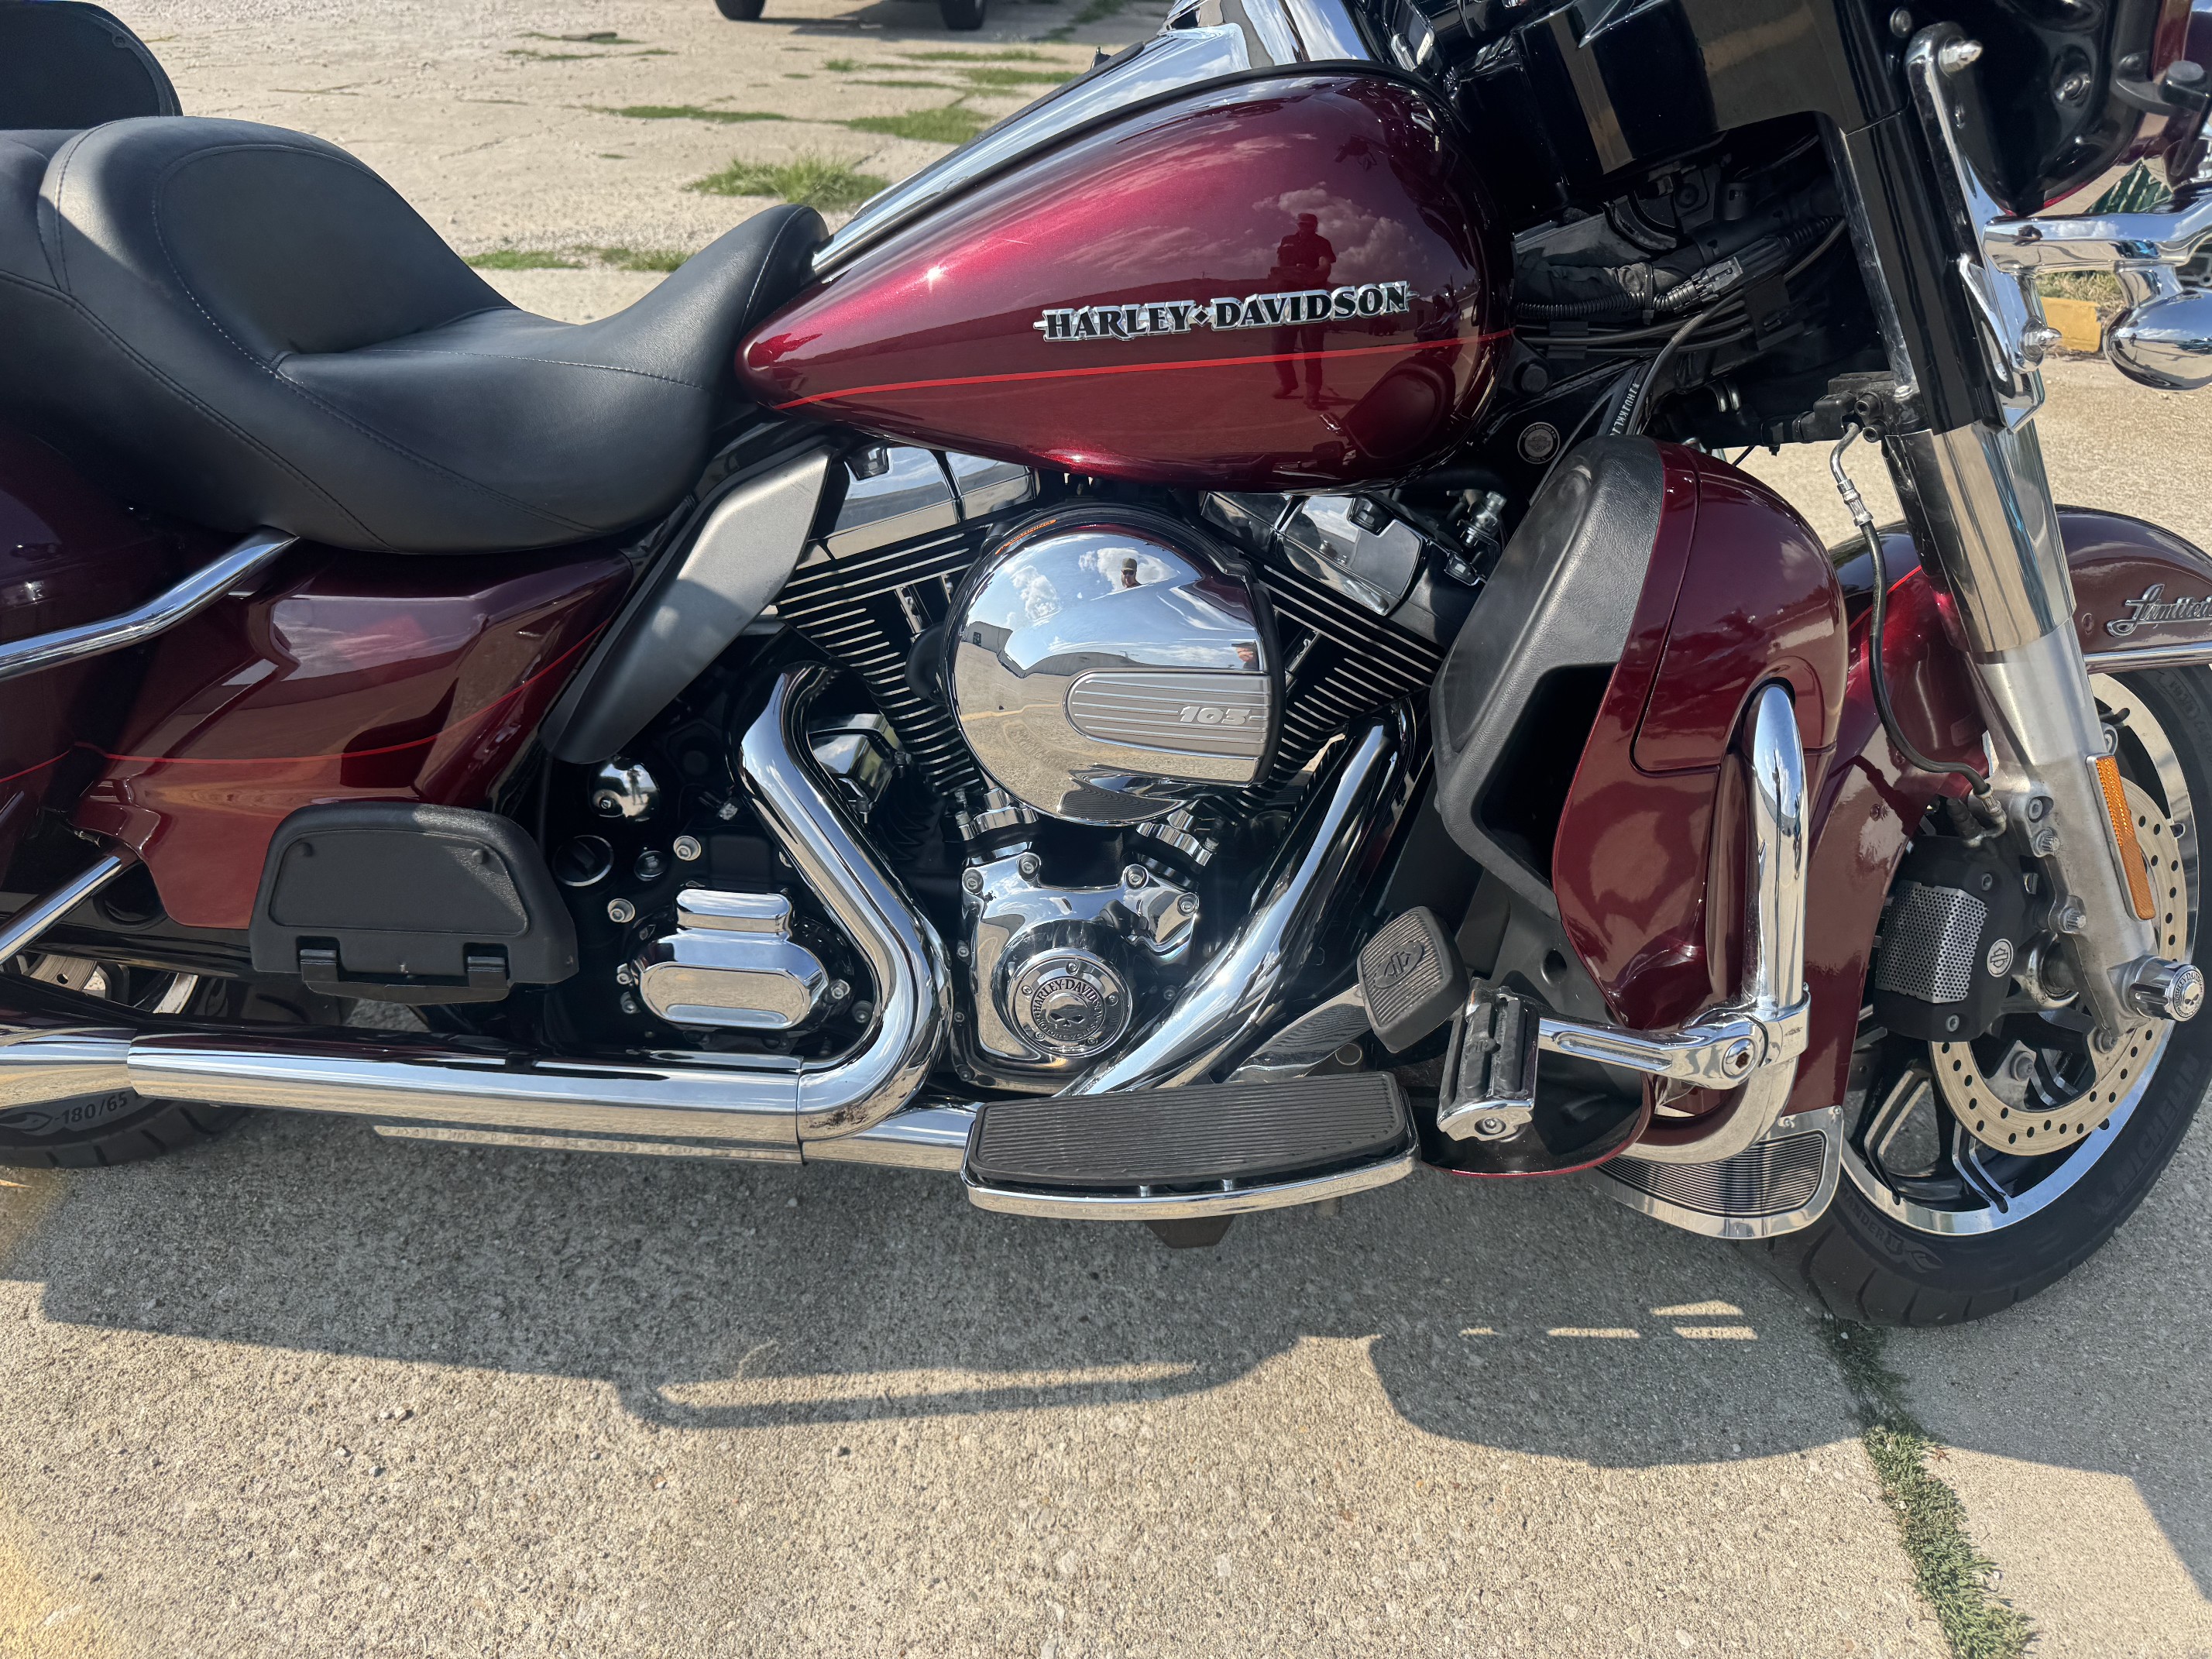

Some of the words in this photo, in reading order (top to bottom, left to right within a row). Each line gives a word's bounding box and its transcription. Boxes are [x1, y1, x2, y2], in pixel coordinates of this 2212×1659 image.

[1043, 300, 1195, 342] HARLEY
[1211, 281, 1410, 331] DAVIDSON
[1180, 706, 1251, 724] 103
[1033, 979, 1103, 1018] HARLEY-DAVIDSON
[61, 1091, 128, 1124] 180/65
